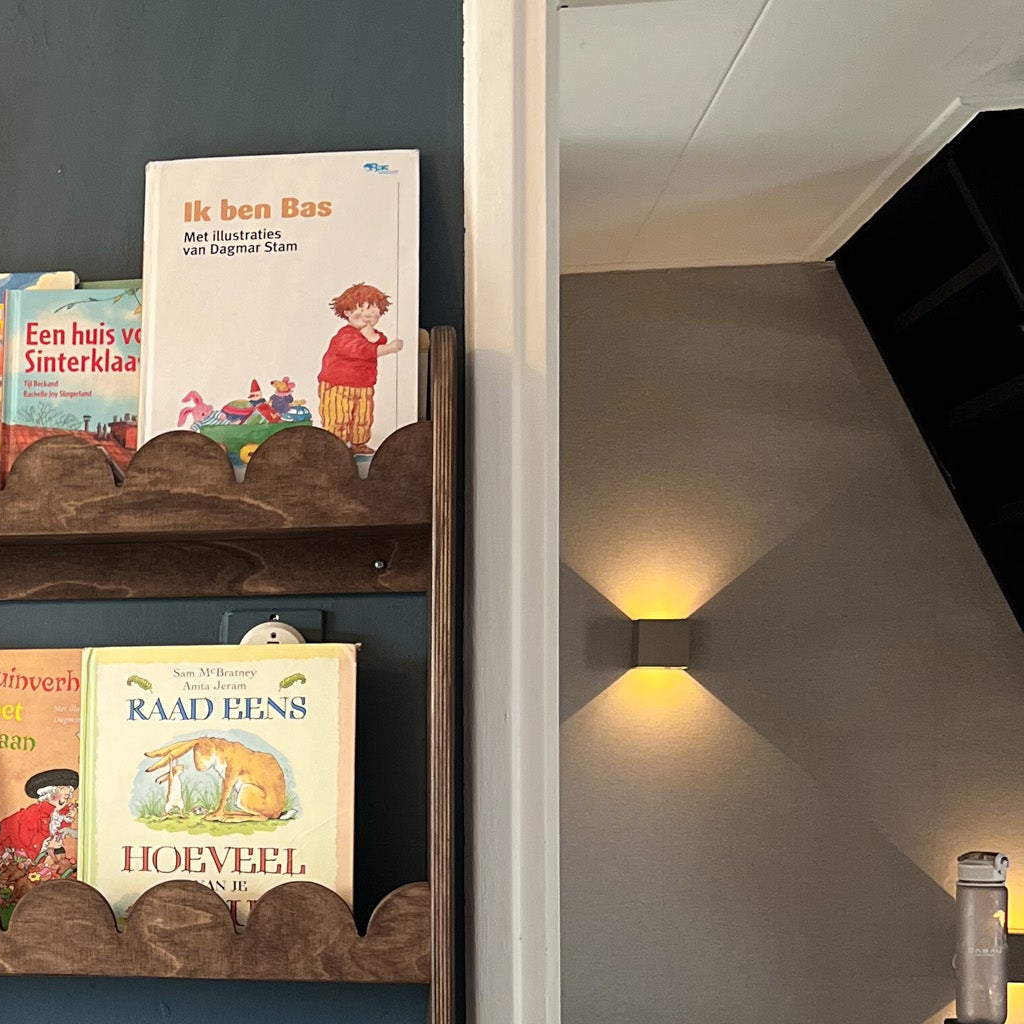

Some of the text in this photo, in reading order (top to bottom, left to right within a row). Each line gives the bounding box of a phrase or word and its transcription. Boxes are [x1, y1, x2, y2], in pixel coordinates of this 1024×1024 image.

[183, 197, 333, 223] Ik ben Bas
[184, 228, 282, 243] Met illustraties
[183, 240, 298, 257] van Dagmar Stam
[26, 322, 65, 345] Een
[71, 321, 116, 345] huis
[24, 348, 141, 373] Sinterklaa
[173, 667, 257, 680] Sam McBratney
[182, 680, 247, 691] Anita Jeram
[125, 696, 307, 721] RAAD EENS
[121, 845, 306, 876] HOEVEEL
[231, 880, 248, 893] JE
